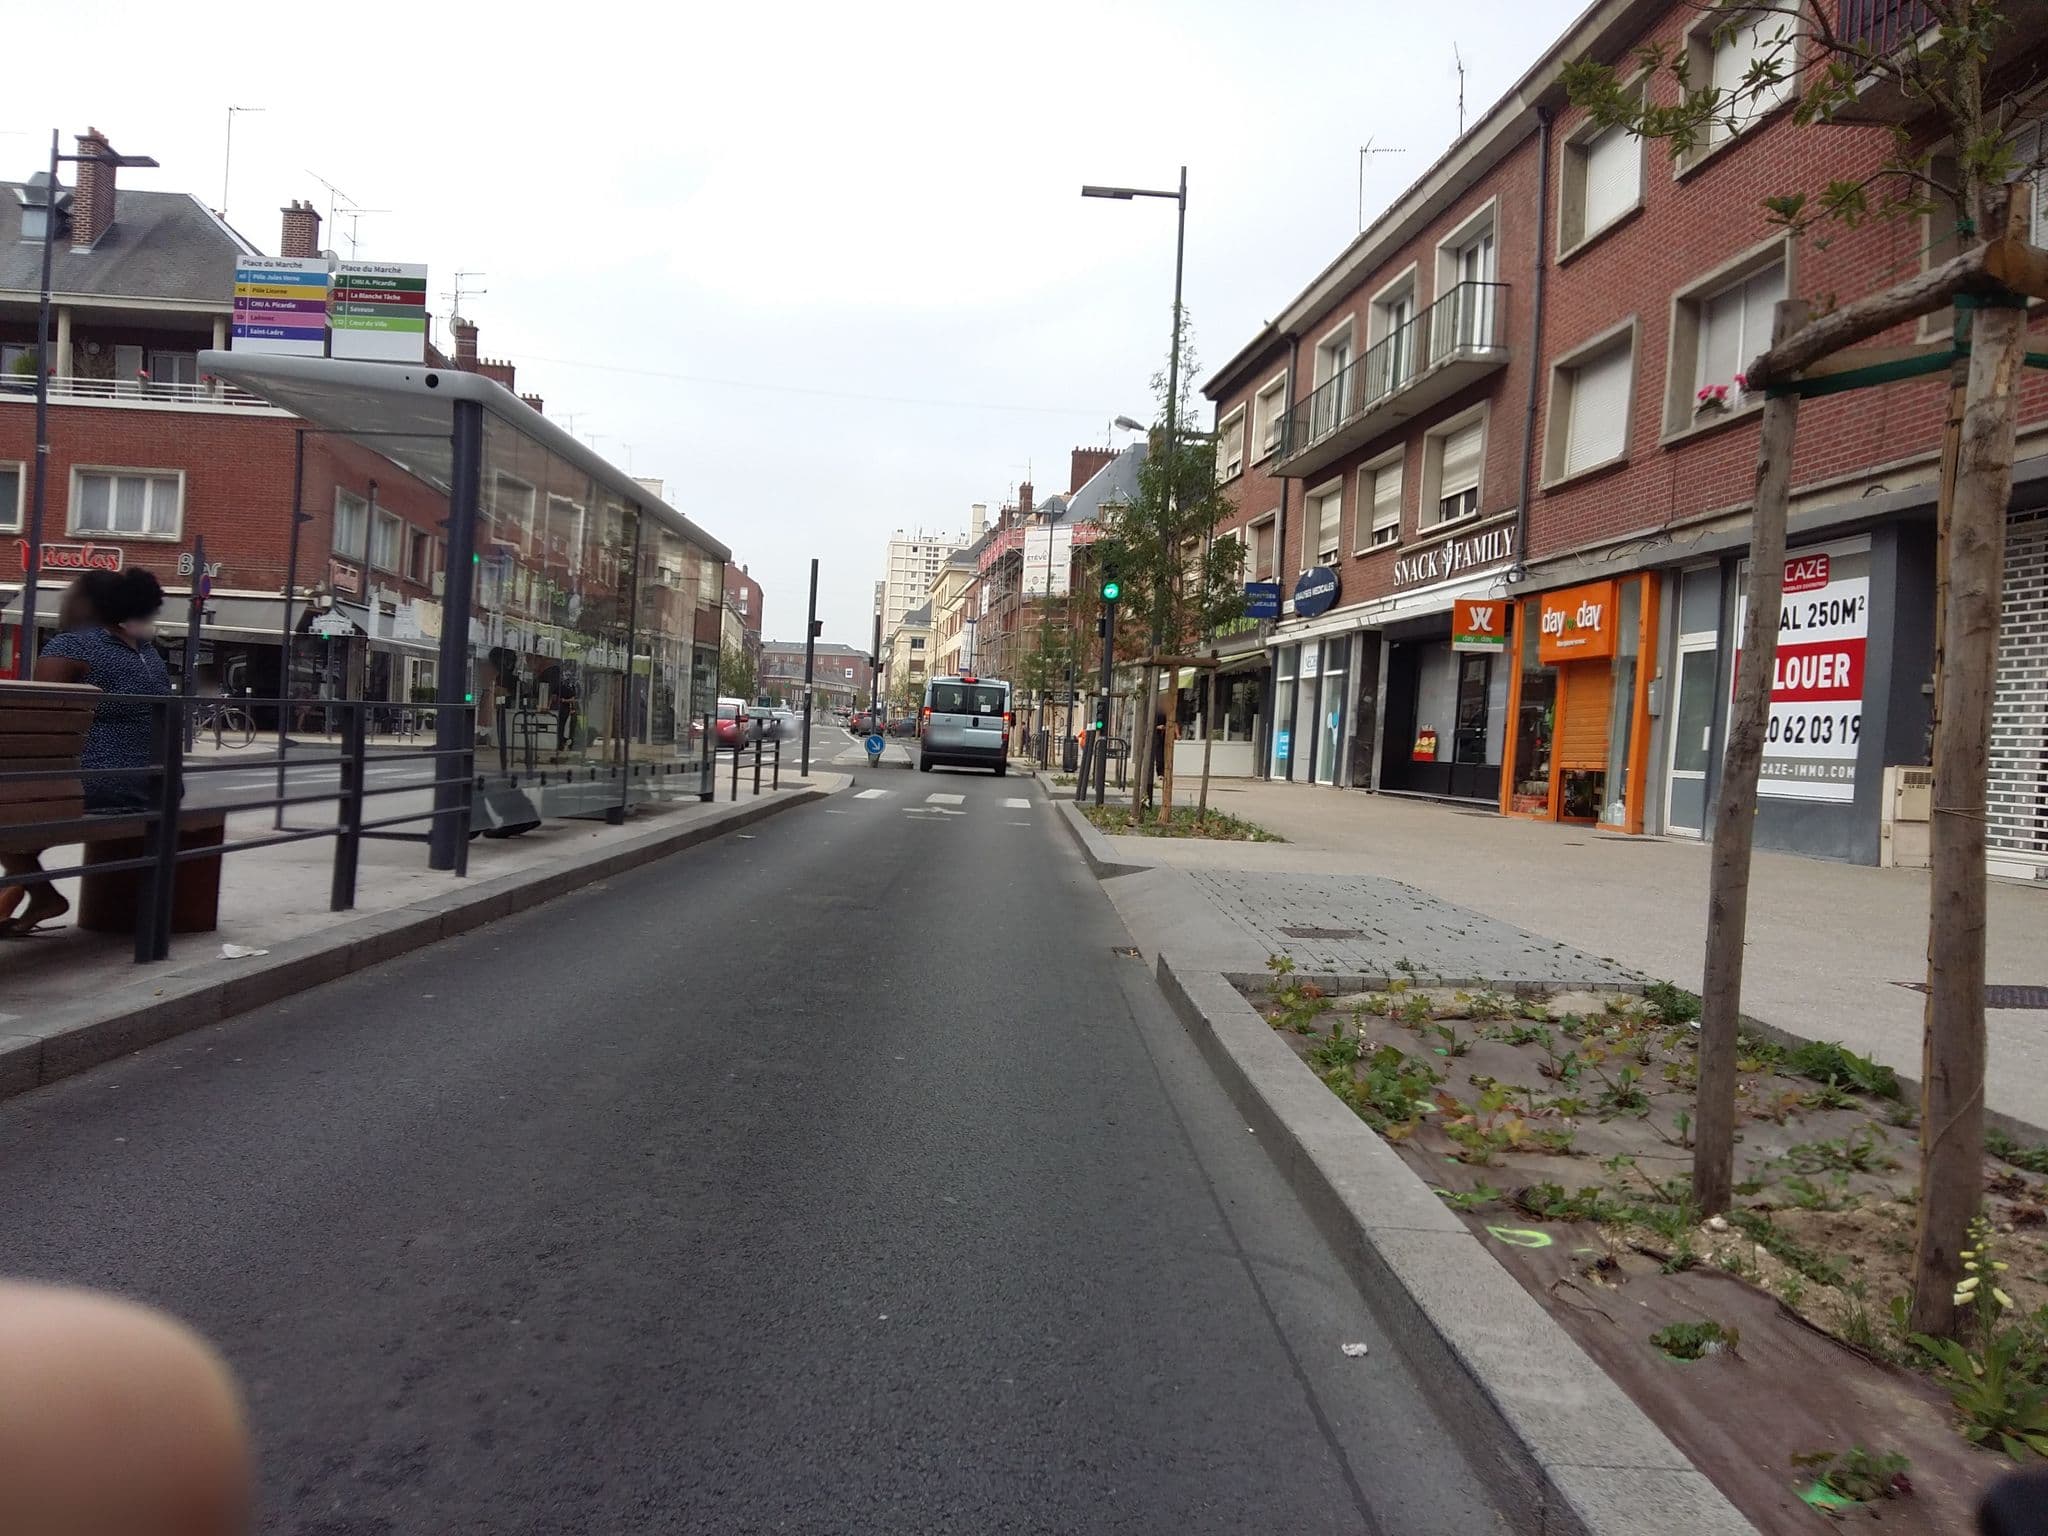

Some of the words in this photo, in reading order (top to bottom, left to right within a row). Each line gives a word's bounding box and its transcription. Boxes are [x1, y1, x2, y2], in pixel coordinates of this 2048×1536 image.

[242, 259, 262, 267] Place
[264, 260, 273, 268] du
[341, 264, 361, 272] Place
[363, 265, 373, 273] du
[249, 328, 284, 336] Saint-Ladre
[1394, 550, 1439, 586] SNACK
[1454, 526, 1516, 571] FAMILY
[1784, 558, 1827, 582] CAZE
[1542, 607, 1565, 637] day
[1576, 600, 1602, 631] day
[1462, 635, 1475, 644] day
[1481, 636, 1493, 645] day
[1772, 653, 1850, 690] LOUER
[1764, 715, 1780, 743] 0
[1783, 715, 1806, 743] 62
[1810, 715, 1833, 744] 03
[1839, 715, 1860, 744] 19
[1760, 763, 1856, 779] CAZE-IMMO.COM
